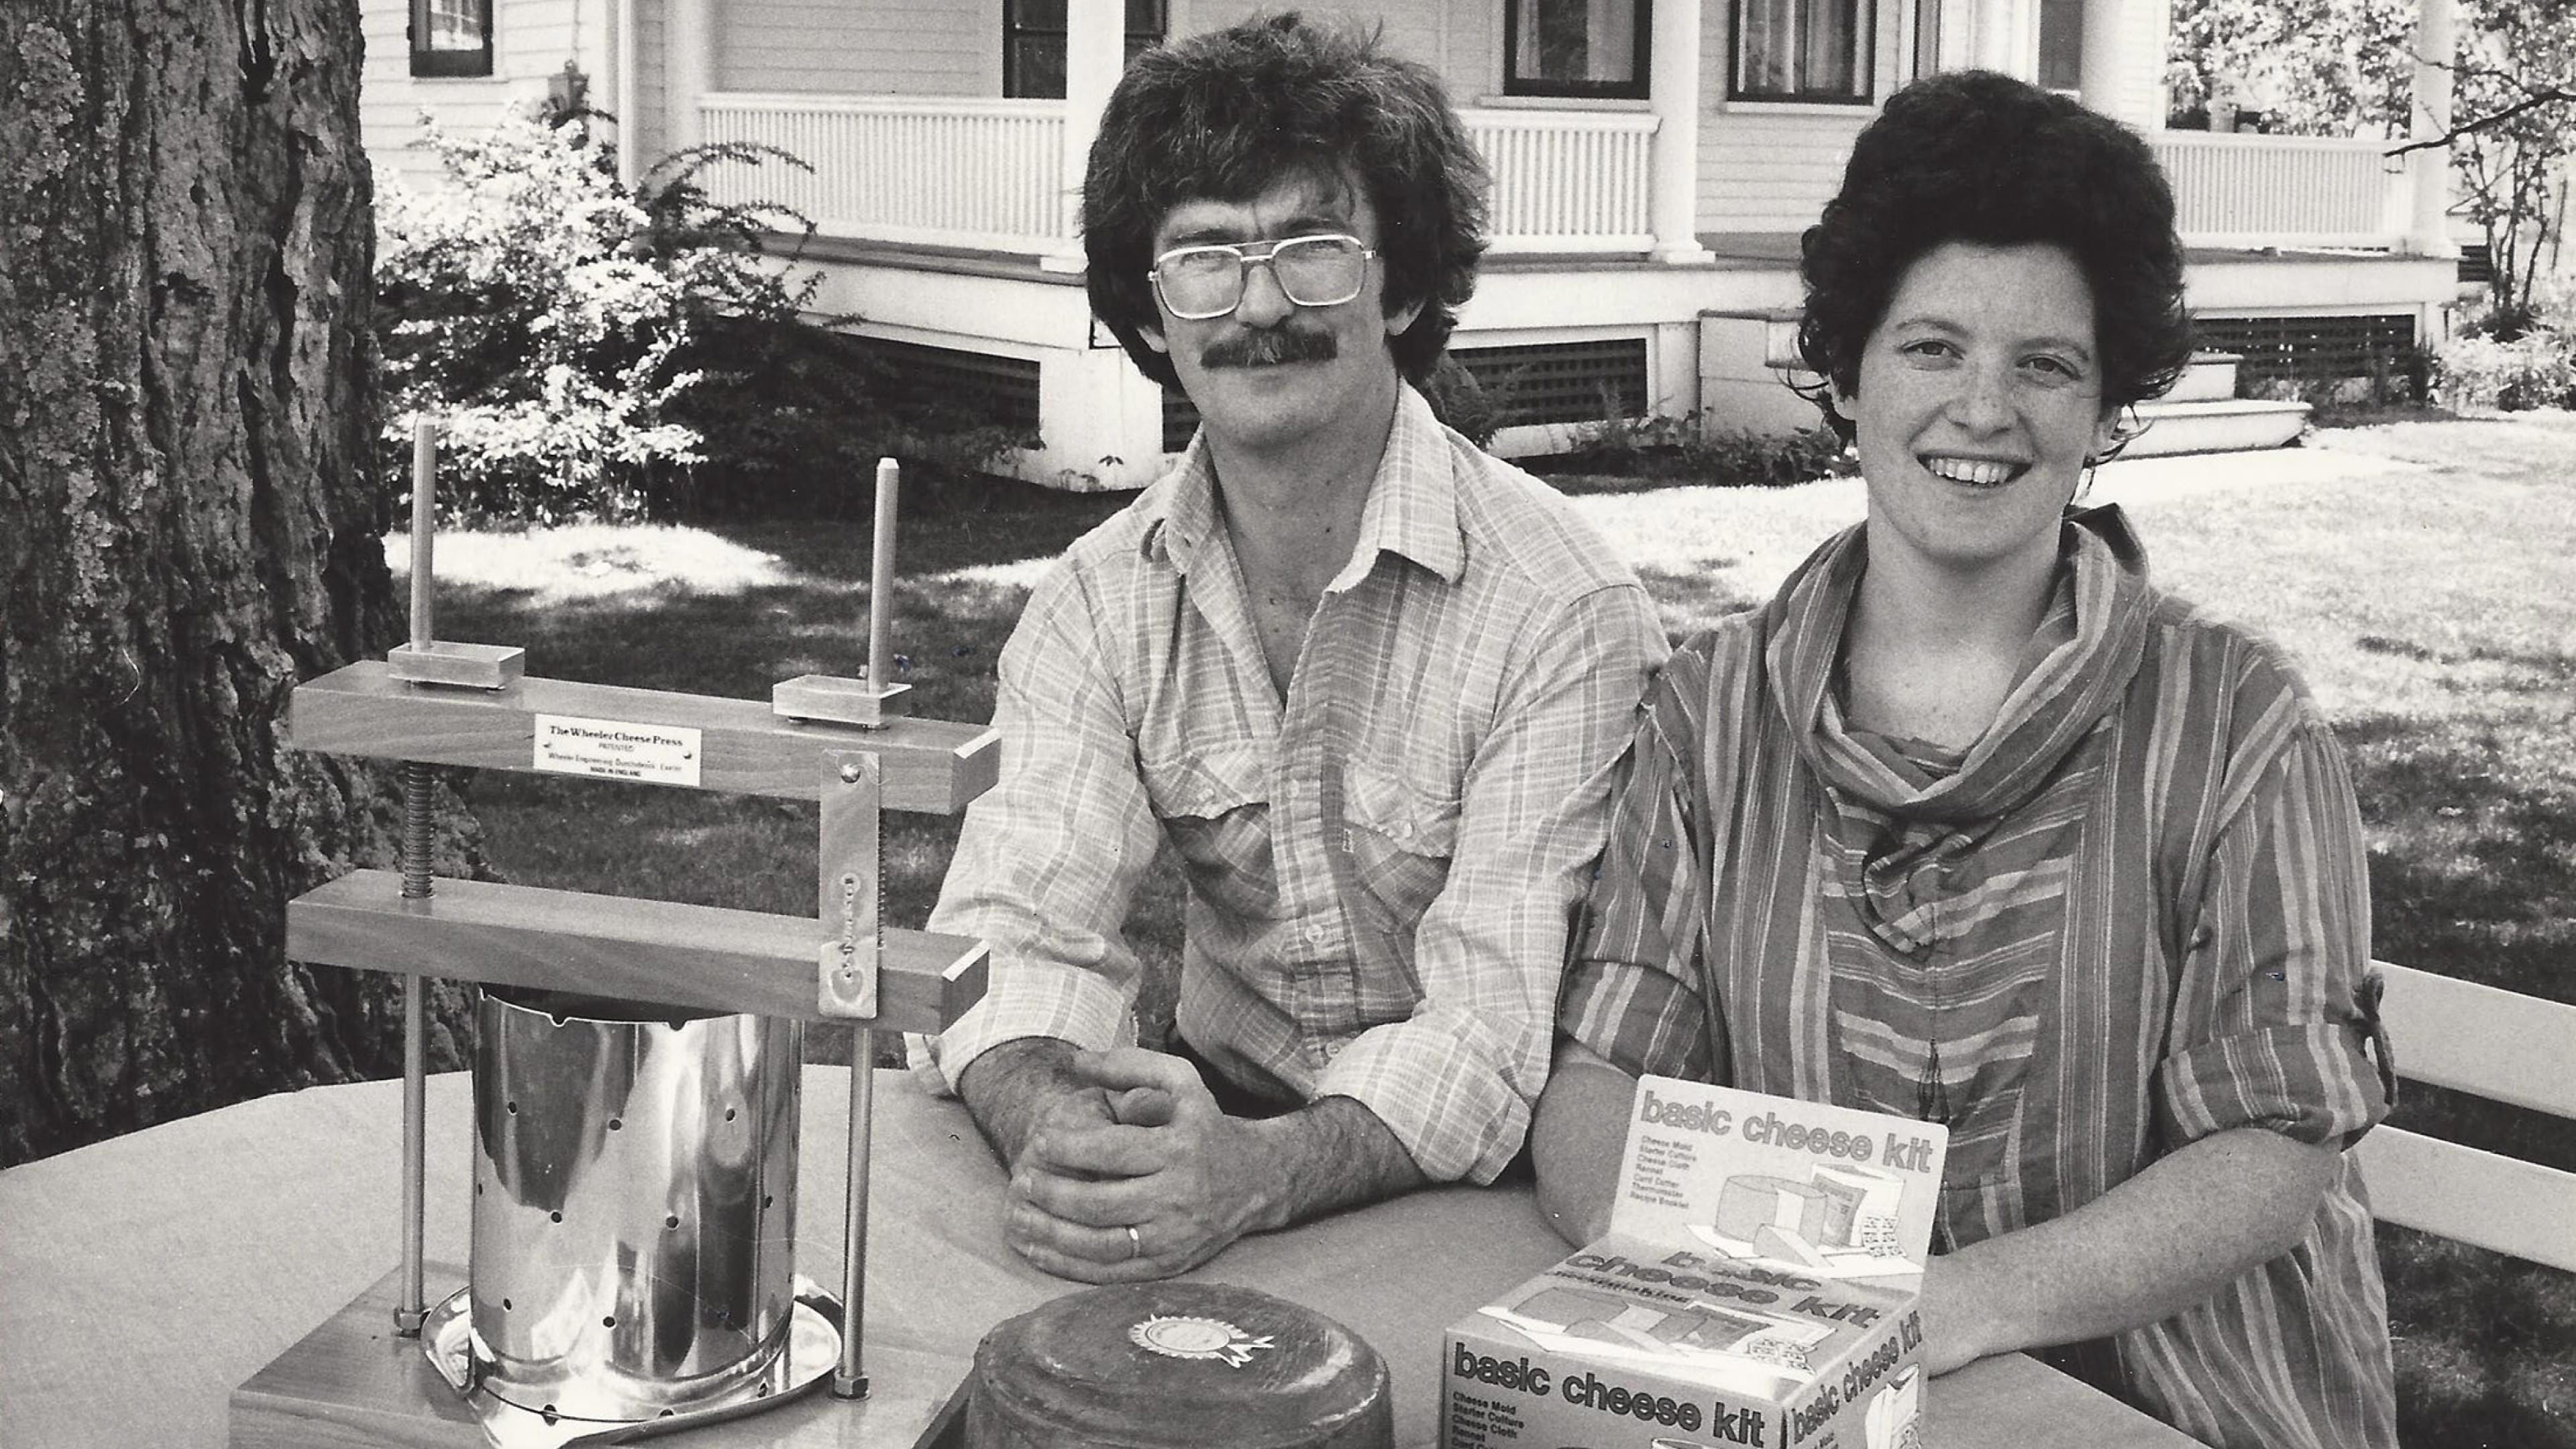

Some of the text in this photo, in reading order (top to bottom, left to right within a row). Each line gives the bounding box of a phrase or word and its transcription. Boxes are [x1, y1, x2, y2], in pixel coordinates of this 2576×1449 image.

[549, 725, 683, 746] The Wheeler Cheese Press
[1640, 1089, 1933, 1173] basic cheese kit
[1565, 1255, 1779, 1304] cheese
[1790, 1296, 1880, 1329] kit
[1452, 1390, 1517, 1415] Cheese Mold
[1454, 1342, 1766, 1449] basic cheese kit
[1790, 1310, 1923, 1444] basic cheese kit
[1452, 1402, 1525, 1430] Starter Culture
[1452, 1413, 1518, 1440] Cheese Cloth
